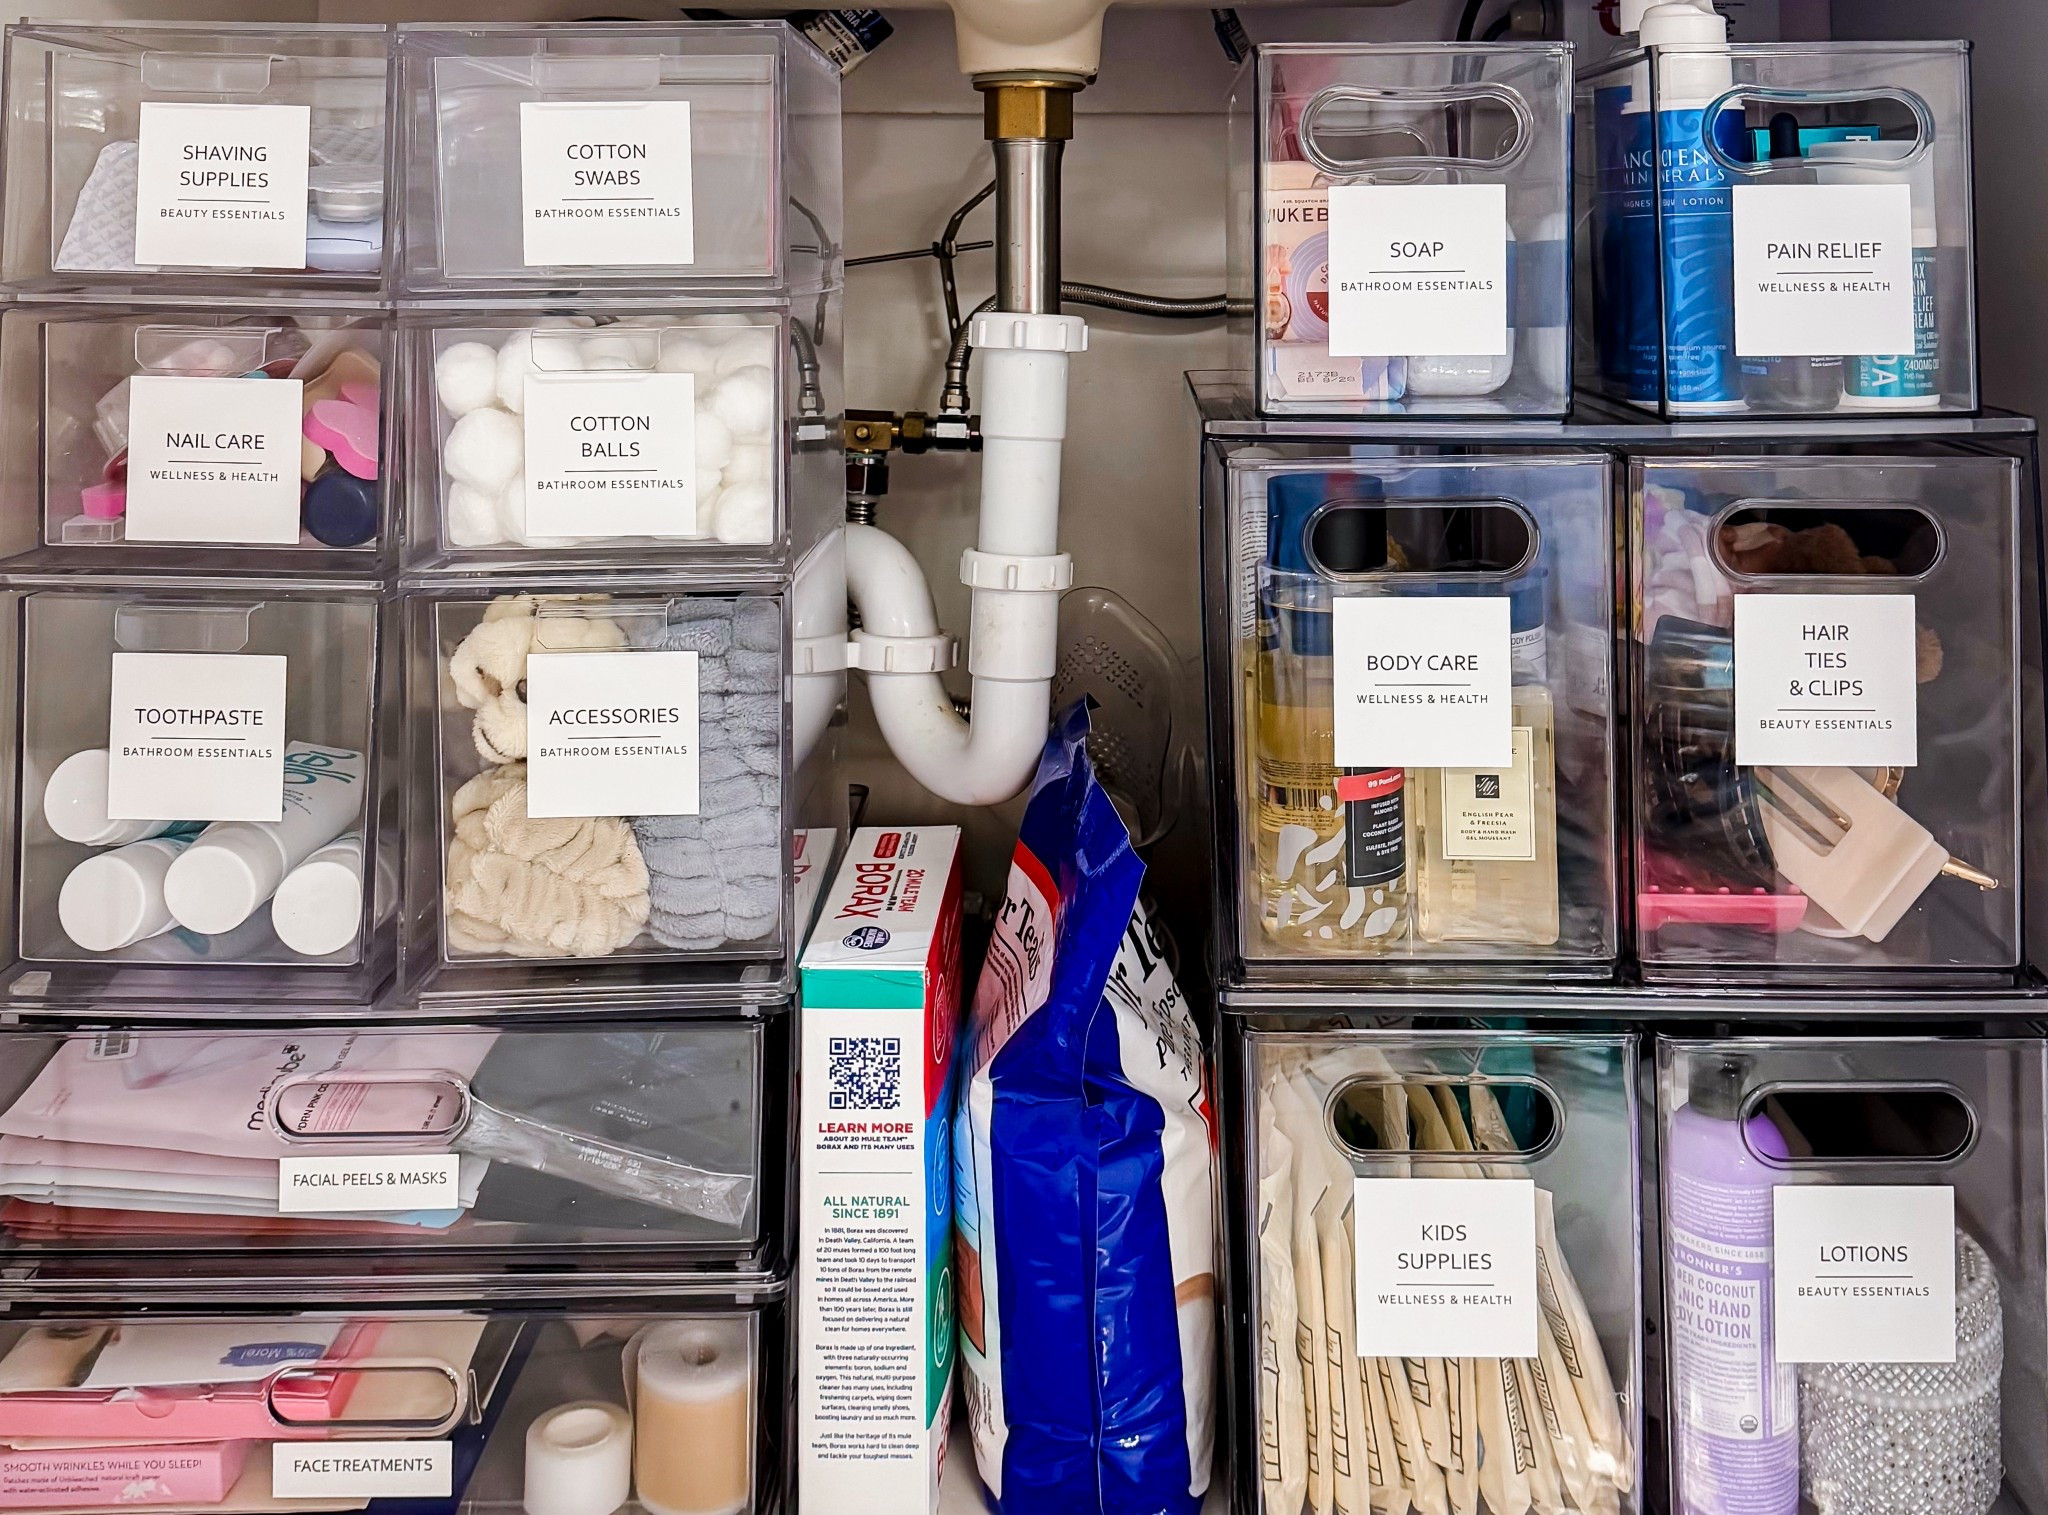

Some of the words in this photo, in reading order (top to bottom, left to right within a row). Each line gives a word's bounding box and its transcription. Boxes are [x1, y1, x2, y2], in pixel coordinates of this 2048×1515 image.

[183, 144, 267, 162] SHAVING
[566, 143, 646, 160] COTTON
[179, 170, 269, 188] SUPPLIES
[574, 169, 641, 186] SWABS
[1682, 196, 1724, 206] LOTION
[160, 208, 208, 218] BEAUTY
[212, 209, 285, 221] ESSENTIALS
[535, 208, 604, 218] BATHROOM
[608, 207, 681, 218] ESSENTIALS
[1390, 241, 1444, 258] SOAP
[1767, 242, 1812, 260] PAIN
[1817, 242, 1882, 259] RELIEF
[1913, 263, 1925, 279] AX
[1340, 281, 1412, 292] BATHROOM
[1417, 280, 1493, 291] ESSENTIALS
[1758, 282, 1826, 293] WELLNESS
[1829, 282, 1838, 292] &
[1842, 281, 1891, 292] HEALTH
[570, 415, 650, 432] COTTON
[166, 432, 211, 449] NAIL
[214, 433, 265, 450] CARE
[581, 441, 640, 458] BALLS
[149, 470, 215, 481] WELLNESS
[218, 471, 227, 481] &
[231, 472, 278, 482] HEALTH
[537, 480, 607, 490] BATHROOM
[611, 479, 684, 489] ESSENTIALS
[1802, 624, 1849, 641] HAIR
[1367, 654, 1423, 671] BODY
[1427, 654, 1479, 671] CARE
[1804, 652, 1847, 669] TIES
[1789, 679, 1804, 697] &
[1808, 679, 1863, 697] CLIPS
[1356, 694, 1423, 704] WELLNESS
[1427, 694, 1436, 704] &
[1440, 694, 1488, 704] HEALTH
[134, 708, 264, 726] TOOTHPASTE
[548, 707, 679, 725] ACCESSORIES
[1760, 719, 1811, 730] BEAUTY
[1815, 719, 1893, 730] ESSENTIALS
[123, 746, 193, 758] BATHROOM
[197, 748, 272, 759] ESSENTIALS
[540, 746, 610, 757] BATHROOM
[614, 745, 688, 756] ESSENTIALS
[1362, 829, 1387, 838] COCONUT
[833, 862, 897, 920] BORAX
[307, 1093, 324, 1109] PINK
[818, 1122, 868, 1134] LEARN
[871, 1122, 914, 1134] MORE
[823, 1135, 849, 1143] ABOUT
[293, 1173, 340, 1187] FACIAL
[342, 1172, 384, 1186] PEELS
[386, 1172, 397, 1186] &
[400, 1171, 447, 1185] MASKS
[823, 1195, 848, 1207] ALL
[851, 1195, 911, 1207] NATURAL
[832, 1208, 870, 1219] SINCE
[872, 1208, 899, 1219] 1891
[1421, 1224, 1467, 1242] KIDS
[1397, 1252, 1492, 1270] SUPPLIES
[1820, 1245, 1908, 1263] LOTIONS
[1697, 1277, 1756, 1299] COCONUT
[1798, 1286, 1848, 1297] BEAUTY
[1852, 1286, 1930, 1297] ESSENTIALS
[1377, 1294, 1445, 1305] WELLNESS
[1450, 1294, 1458, 1305] &
[1463, 1294, 1512, 1305] HEALTH
[1708, 1298, 1751, 1319] HAND
[1697, 1314, 1751, 1340] LOTION
[240, 1347, 282, 1360] More!
[3, 1462, 51, 1473] SMOOTH
[53, 1460, 106, 1471] WRINKLES
[108, 1460, 140, 1470] WHILE
[143, 1459, 166, 1470] YOU
[168, 1459, 202, 1469] SLEEP!
[294, 1459, 331, 1473] FACE
[332, 1457, 433, 1473] TREATMENTS
